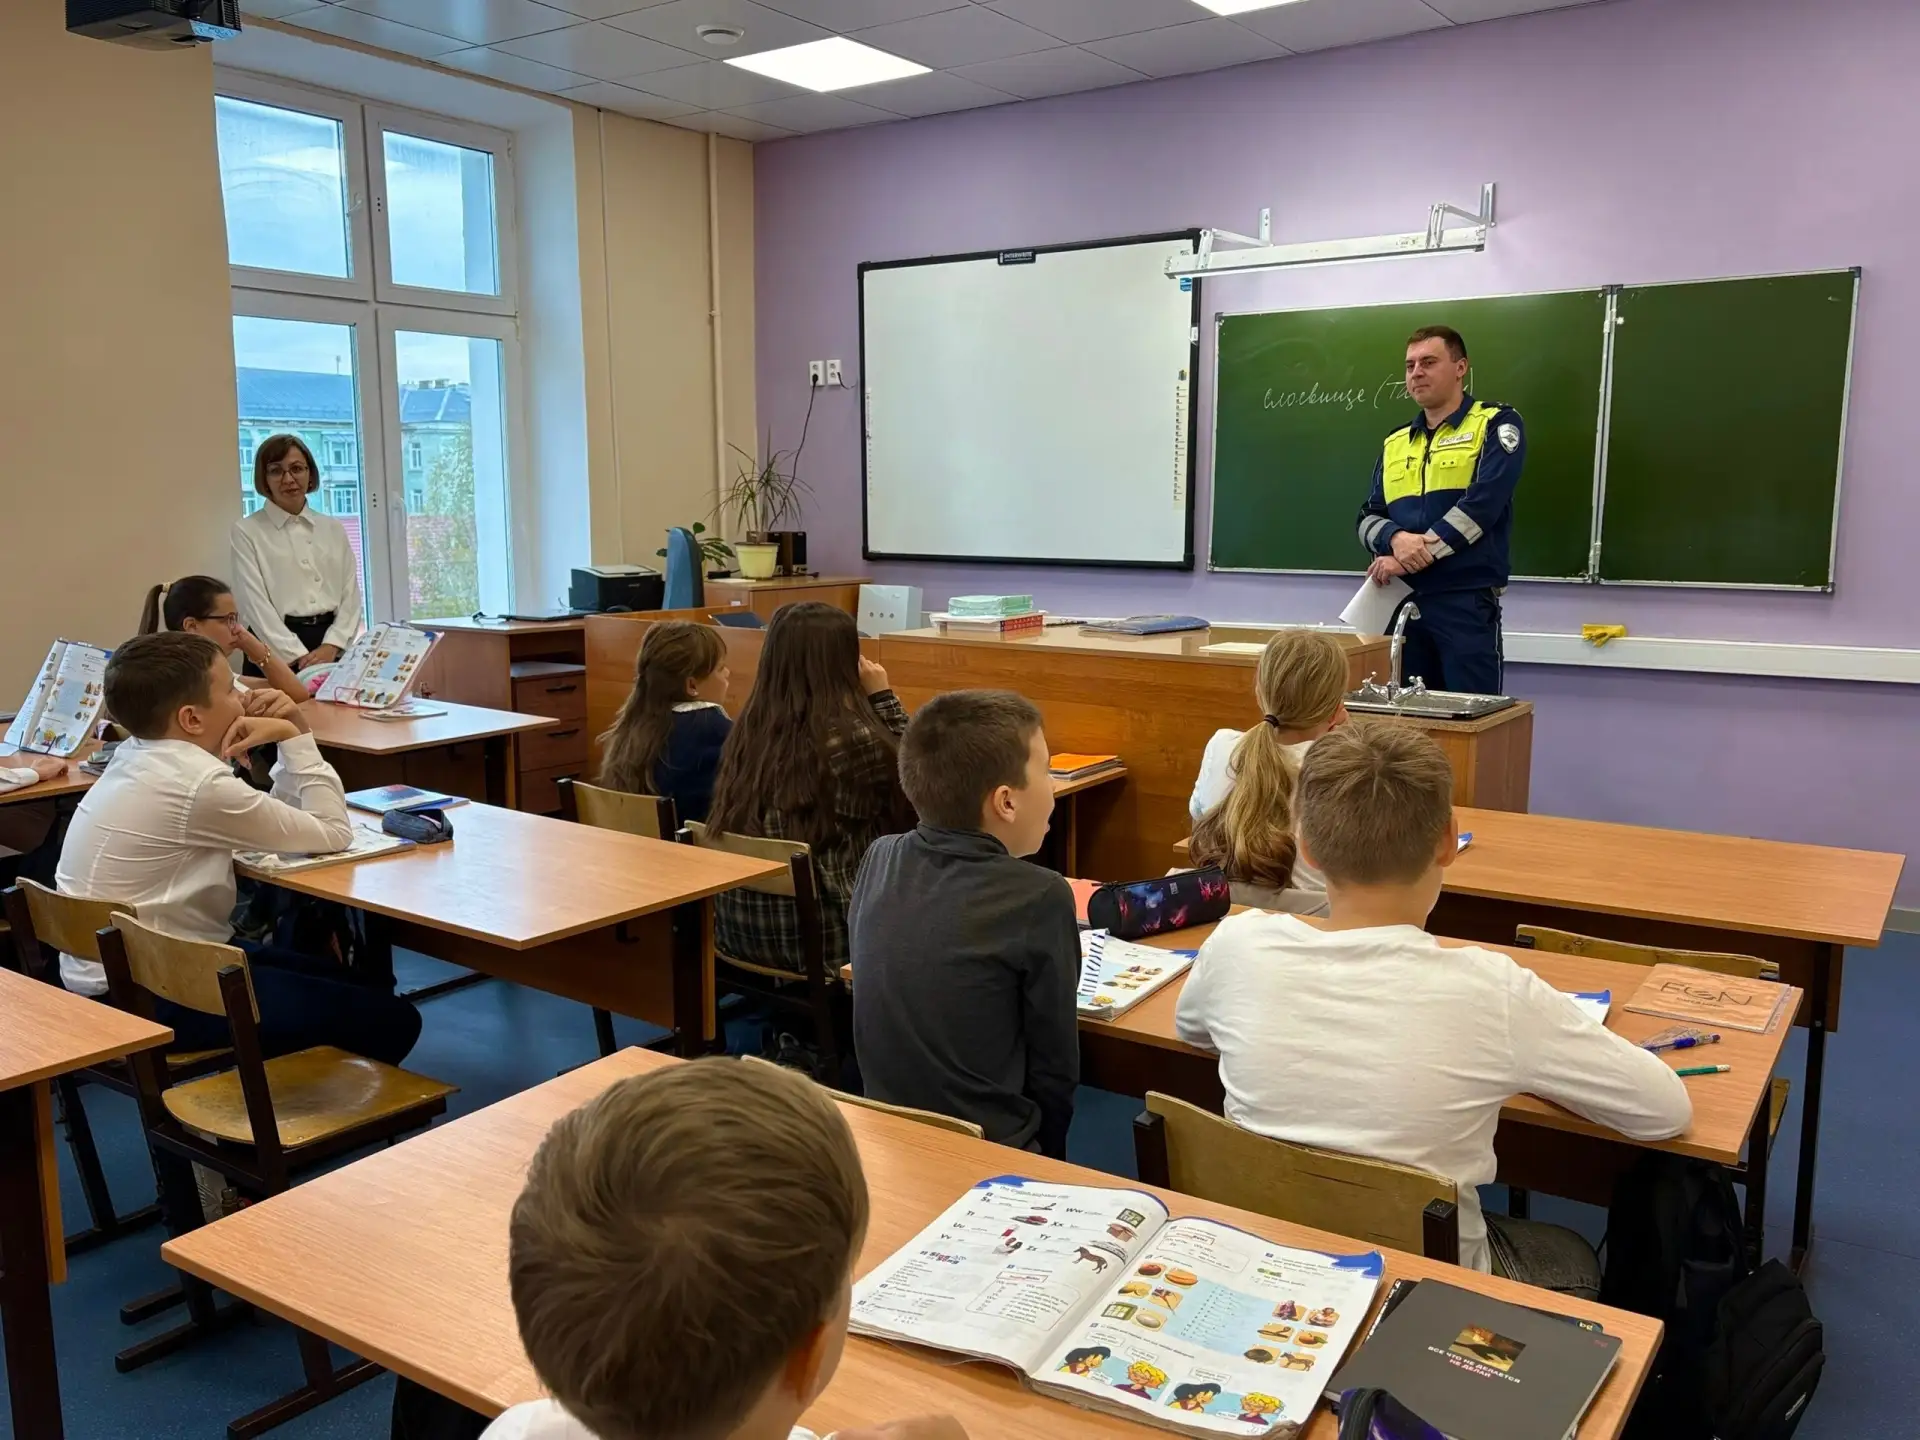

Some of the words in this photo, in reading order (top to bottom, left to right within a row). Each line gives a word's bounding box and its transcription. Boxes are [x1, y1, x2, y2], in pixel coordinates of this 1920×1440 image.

[1427, 1345, 1445, 1355] ВСЕ
[1446, 1351, 1462, 1361] ЧТО
[1463, 1358, 1476, 1366] НЕ
[1475, 1363, 1521, 1384] ДЕЛАЕТСЯ
[1449, 1358, 1462, 1367] НЕ
